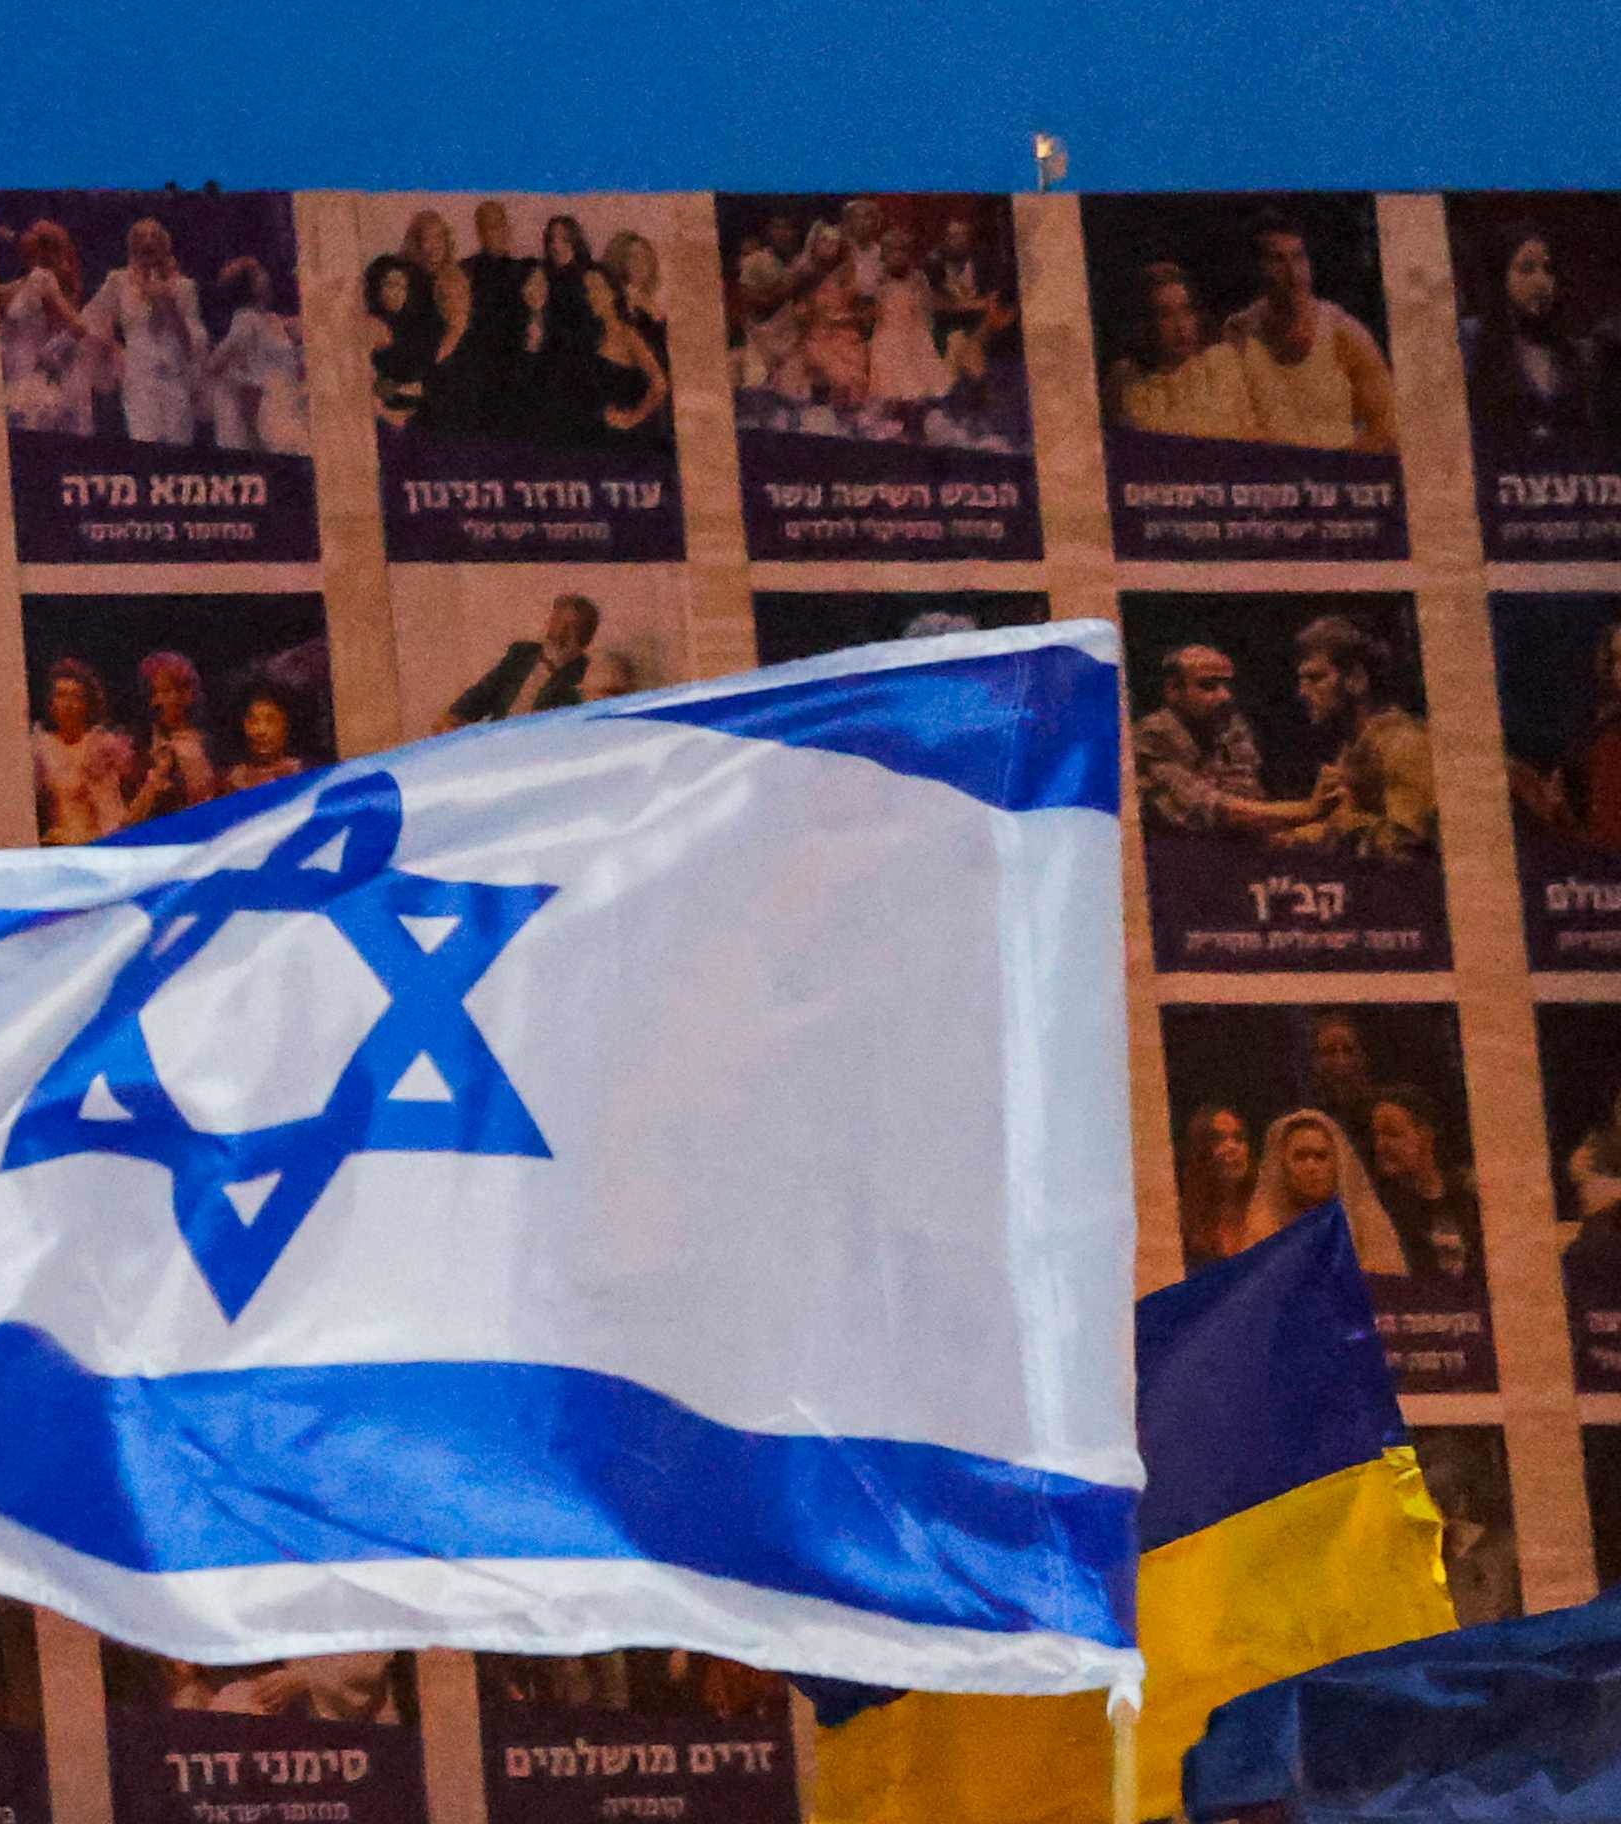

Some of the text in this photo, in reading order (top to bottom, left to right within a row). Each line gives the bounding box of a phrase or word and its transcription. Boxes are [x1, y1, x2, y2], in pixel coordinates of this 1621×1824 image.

[62, 473, 267, 507] מאמא מיה
[402, 479, 662, 514] עוד חוזר הניגון
[830, 481, 931, 509] השישה
[939, 481, 1019, 509] הכבש
[164, 1749, 369, 1793] סימני דרך
[505, 1736, 773, 1778] זרים מושלמים
